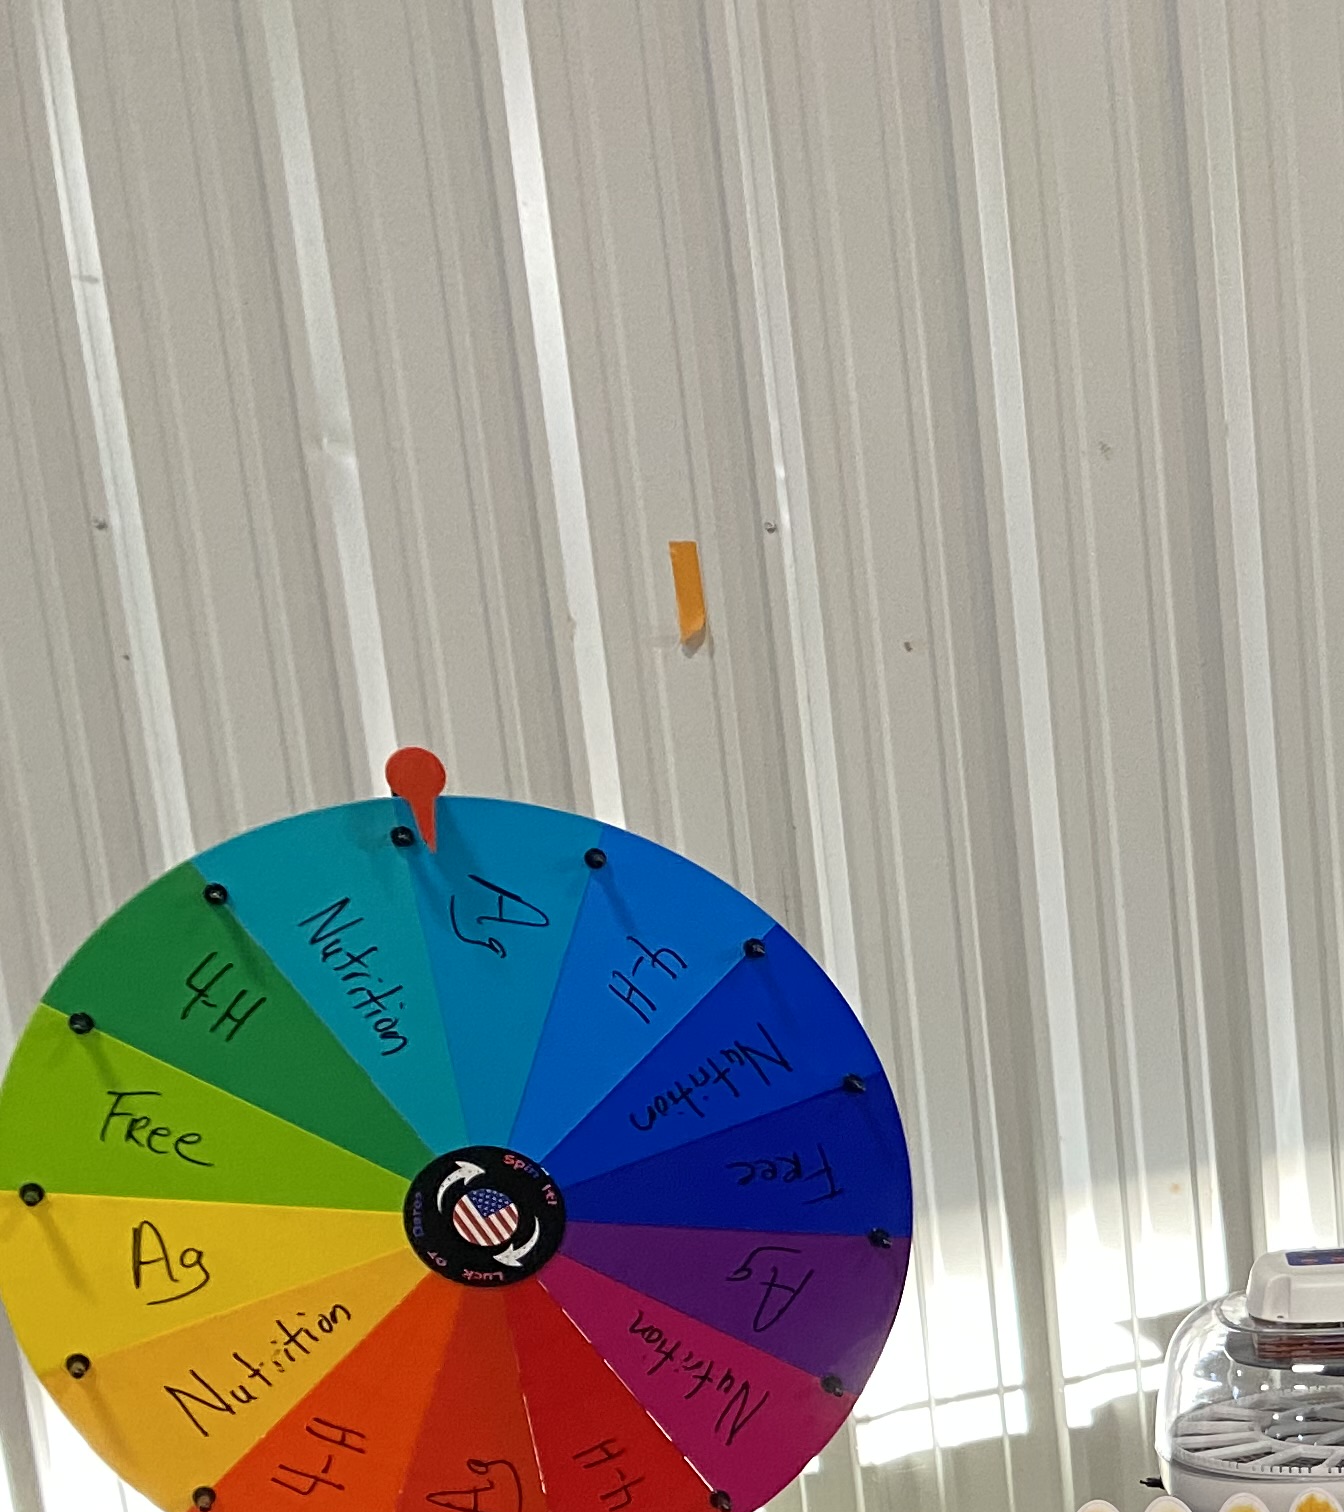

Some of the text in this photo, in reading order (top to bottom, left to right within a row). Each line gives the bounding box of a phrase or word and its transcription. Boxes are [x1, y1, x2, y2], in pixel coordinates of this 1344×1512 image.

[451, 874, 550, 959] Ag
[182, 952, 267, 1043] 4-H
[298, 897, 408, 1056] Nutrition
[609, 935, 688, 1024] 4-H
[629, 1022, 793, 1131] Nutrition
[101, 1090, 214, 1167] Free
[729, 1147, 846, 1205] Free
[131, 1219, 212, 1305] Ag
[725, 1246, 815, 1332] Ag
[165, 1301, 352, 1438] Nutrition
[628, 1309, 771, 1446] Nutrition
[272, 1416, 368, 1494] 4-H
[571, 1437, 646, 1512] 4-H
